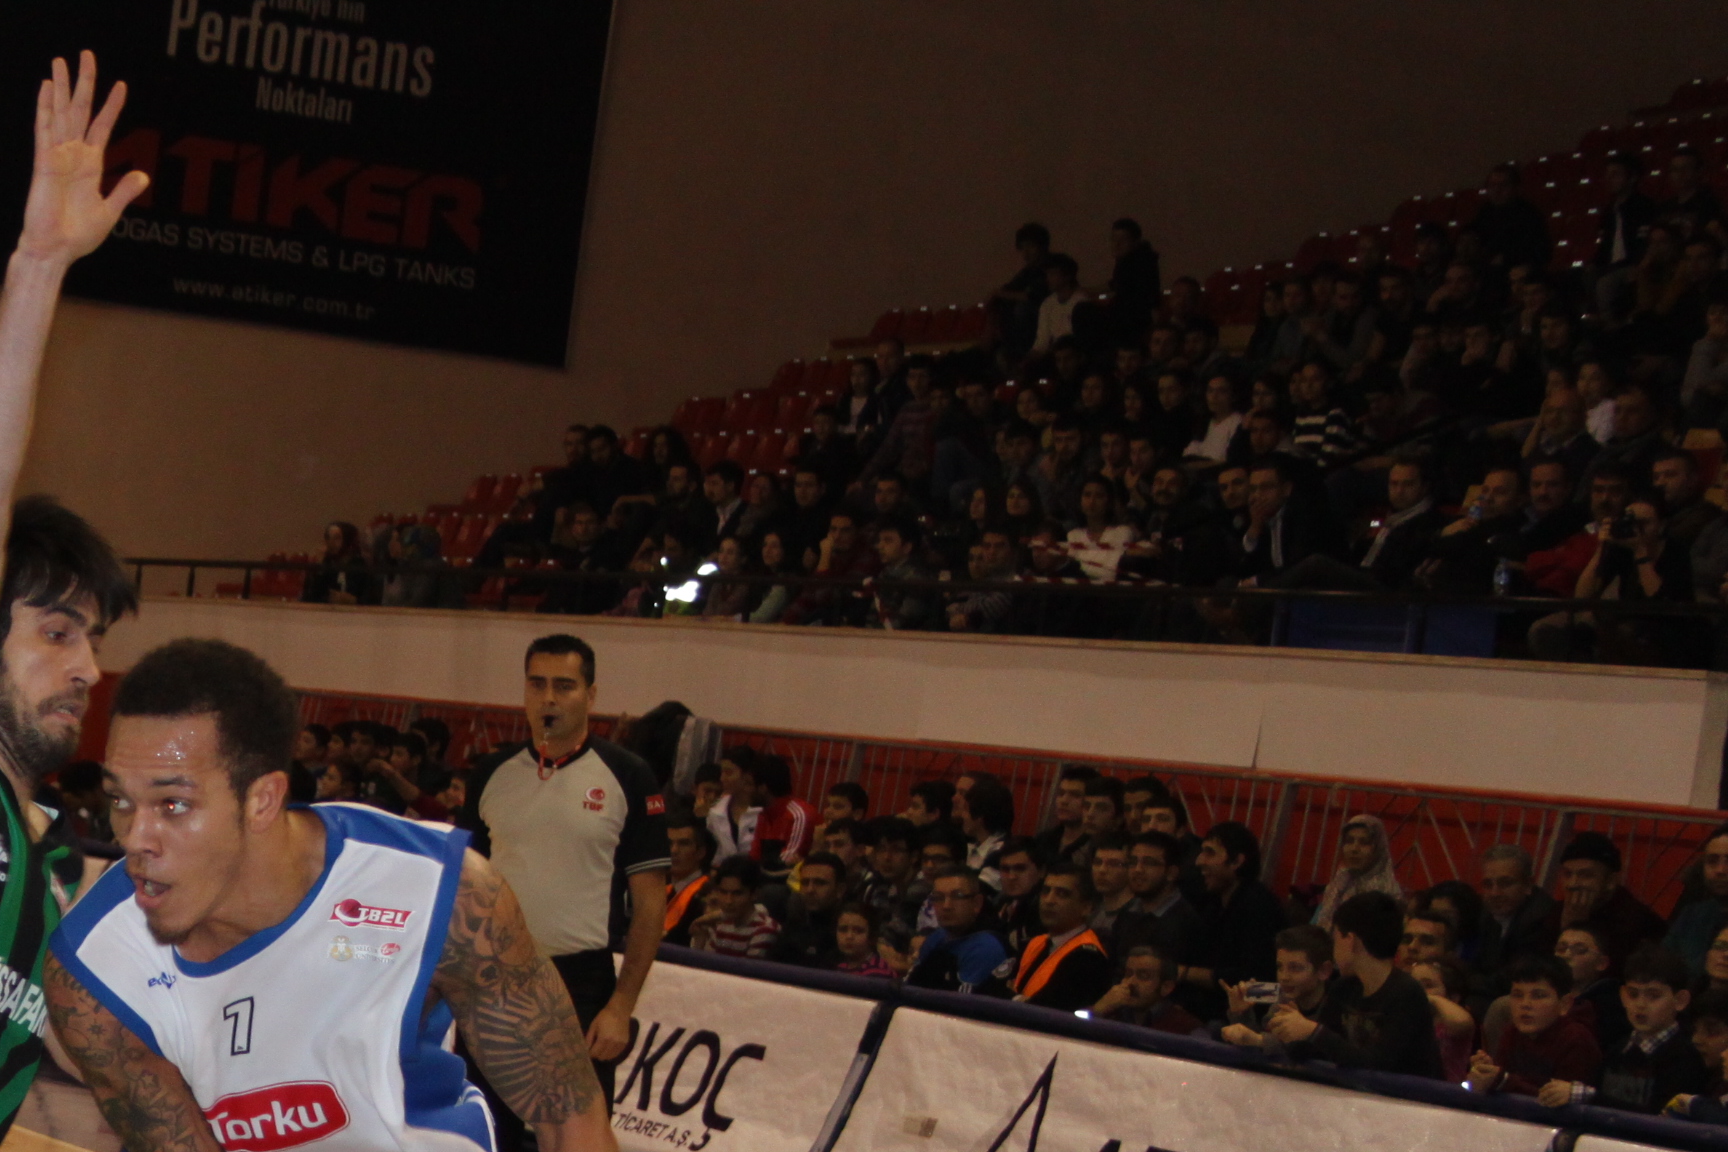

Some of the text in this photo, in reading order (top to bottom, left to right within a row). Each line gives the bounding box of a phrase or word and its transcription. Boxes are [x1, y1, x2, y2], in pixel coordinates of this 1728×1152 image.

[165, 0, 435, 98] Performans
[255, 76, 354, 125] Noktaları
[113, 217, 476, 290] OGAS SYSTEMS & LPG TANKS
